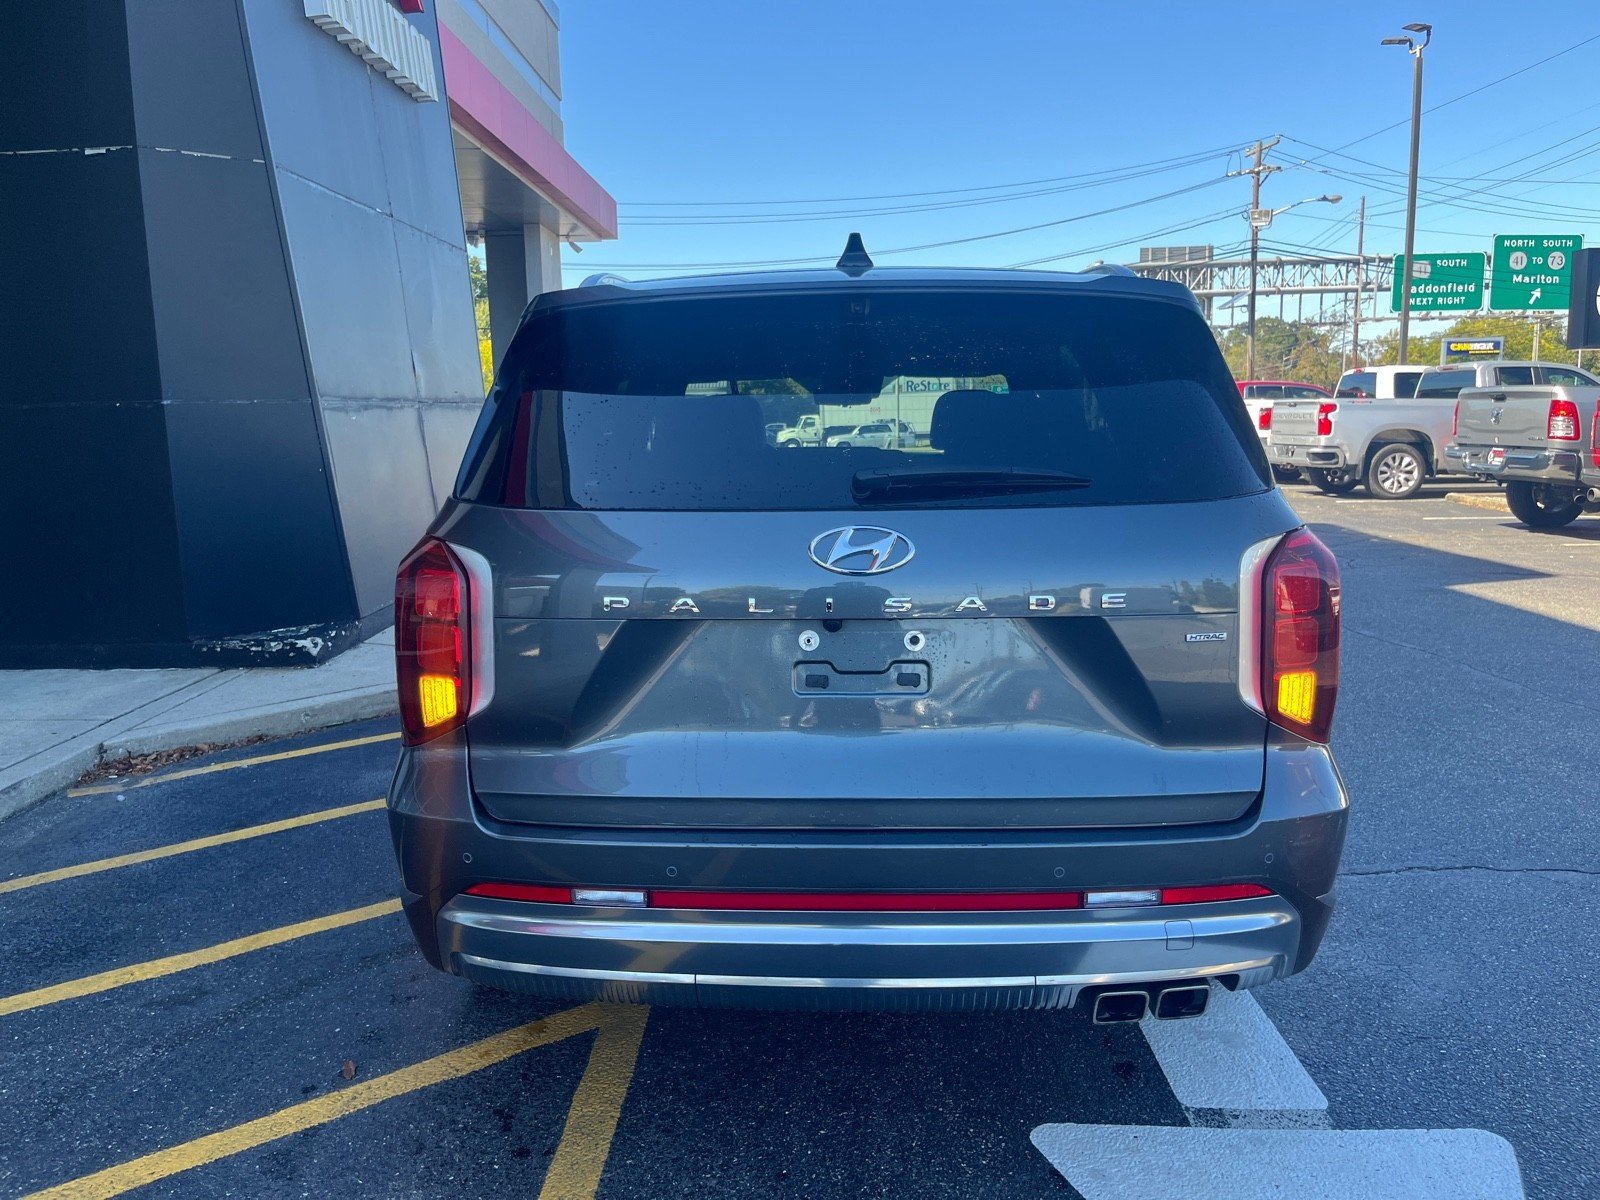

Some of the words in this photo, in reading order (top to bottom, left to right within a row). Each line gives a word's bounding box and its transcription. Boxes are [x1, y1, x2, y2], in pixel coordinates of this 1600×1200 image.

[1504, 239, 1535, 248] NORTH
[1542, 239, 1573, 248] SOUTH
[1436, 258, 1468, 268] SOUTH
[1511, 255, 1524, 266] 41
[1532, 256, 1544, 265] TO
[1549, 255, 1564, 266] 73
[1512, 274, 1560, 284] Marlton
[1402, 281, 1475, 294] addonfield
[1409, 297, 1432, 306] NEXT
[1437, 296, 1466, 306] RIGHT
[906, 379, 951, 392] ReStore
[602, 592, 1128, 614] PALISADE
[1188, 632, 1225, 641] HTRAC
